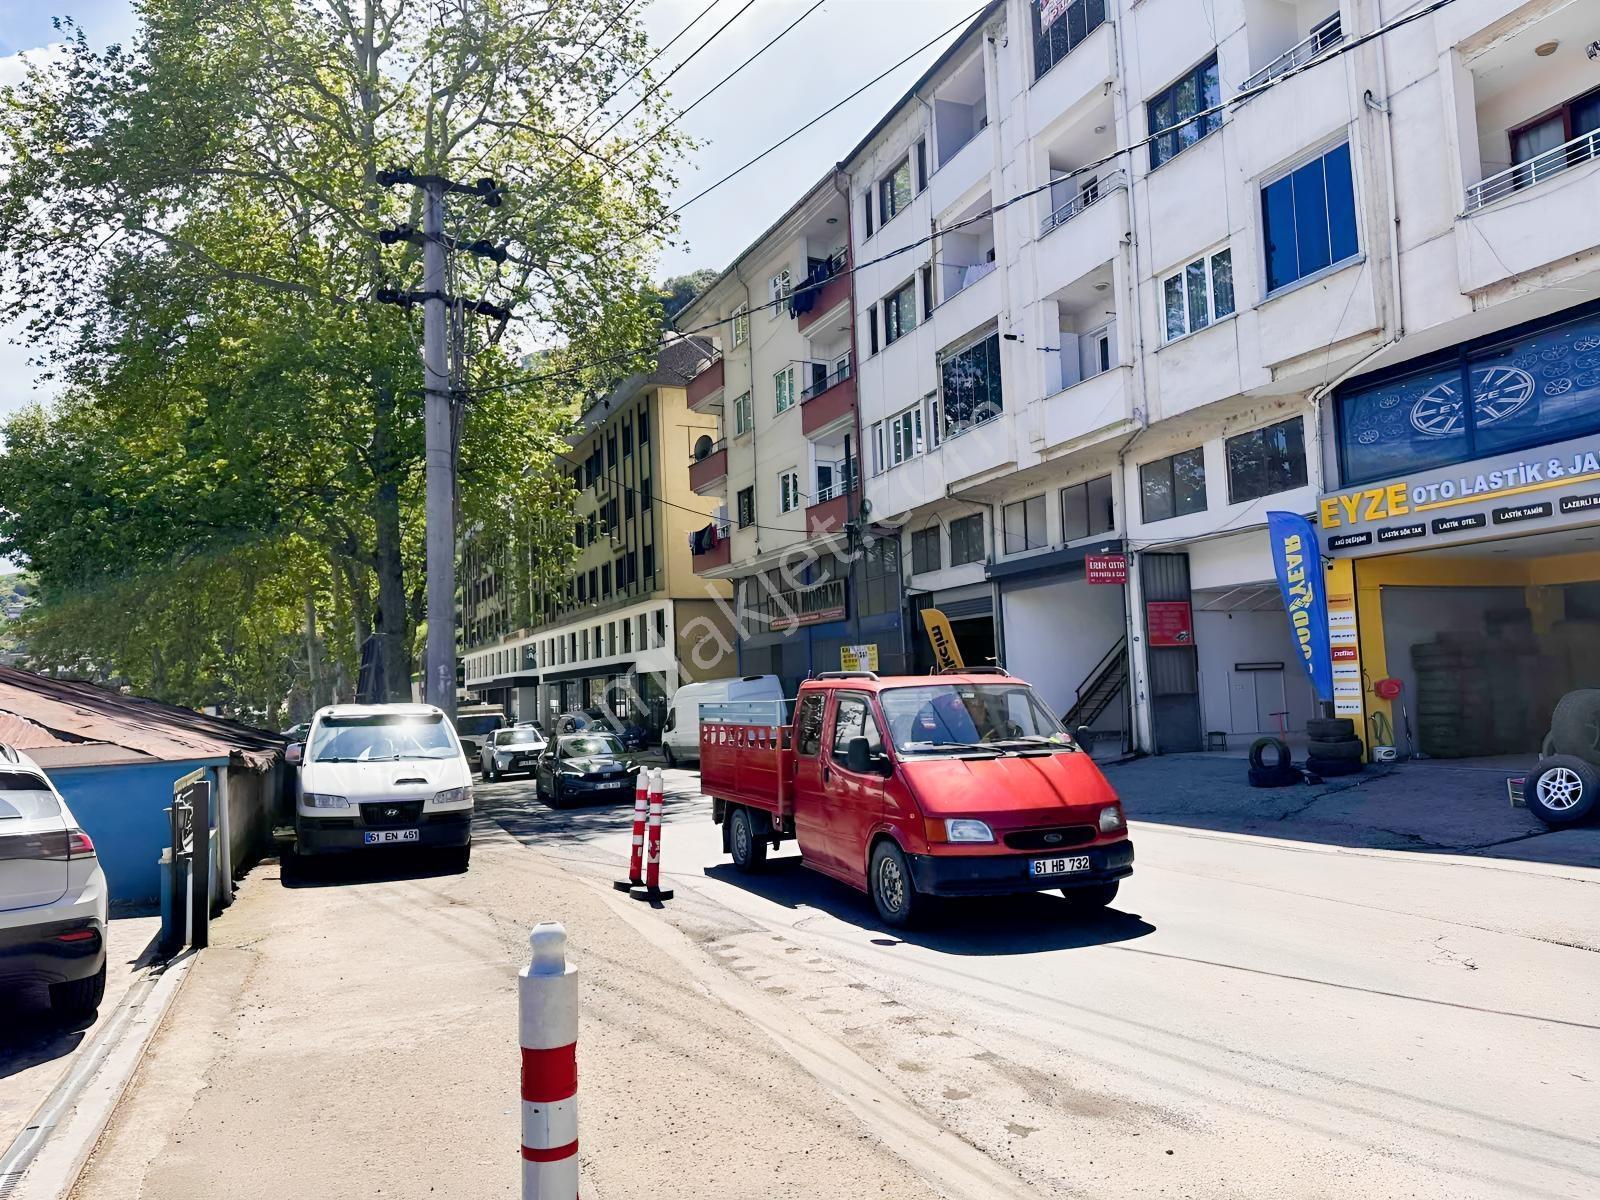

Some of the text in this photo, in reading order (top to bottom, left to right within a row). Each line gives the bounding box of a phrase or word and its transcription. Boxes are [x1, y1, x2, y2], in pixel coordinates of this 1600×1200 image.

[1320, 450, 1600, 528] EYZE OTO LASTİK & JA
[371, 833, 379, 841] 61
[385, 832, 398, 840] EN
[1035, 857, 1088, 874] 61 HB 732
